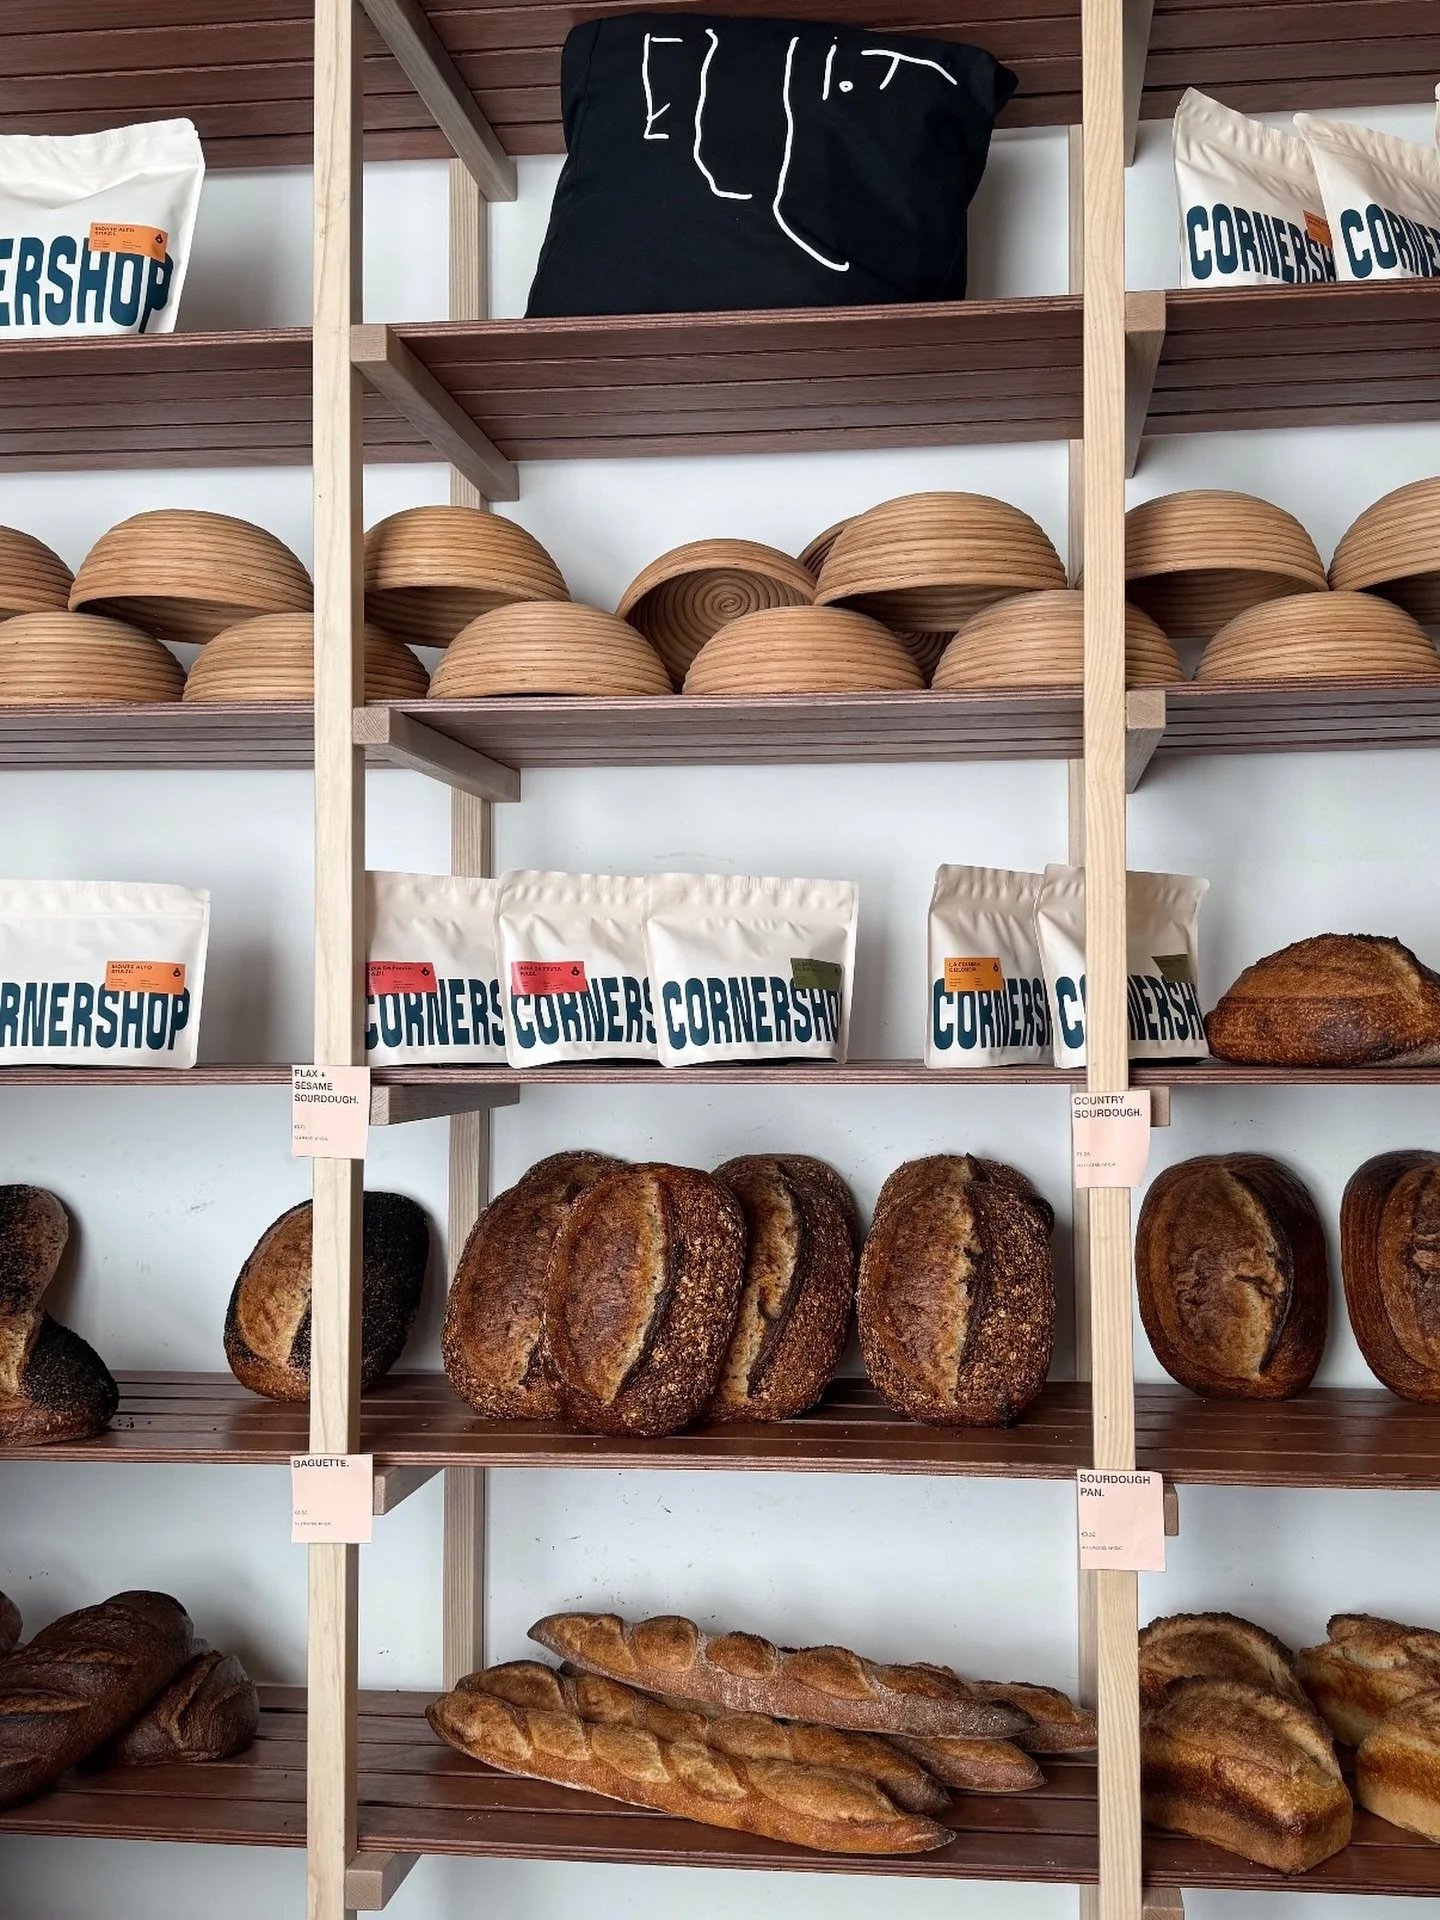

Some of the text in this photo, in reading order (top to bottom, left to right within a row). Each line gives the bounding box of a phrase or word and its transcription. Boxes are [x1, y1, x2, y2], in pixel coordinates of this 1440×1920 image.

[294, 1069, 318, 1078] FLAX
[294, 1081, 333, 1091] SESAME
[294, 1093, 359, 1104] SOURDOUGH.
[1074, 1095, 1125, 1106] COUNTRY
[1074, 1108, 1142, 1118] SOURDOUGH.
[293, 1459, 350, 1468] BAGUETTE.
[1080, 1474, 1151, 1484] SOURDOUGH
[1080, 1488, 1105, 1497] PAN.
